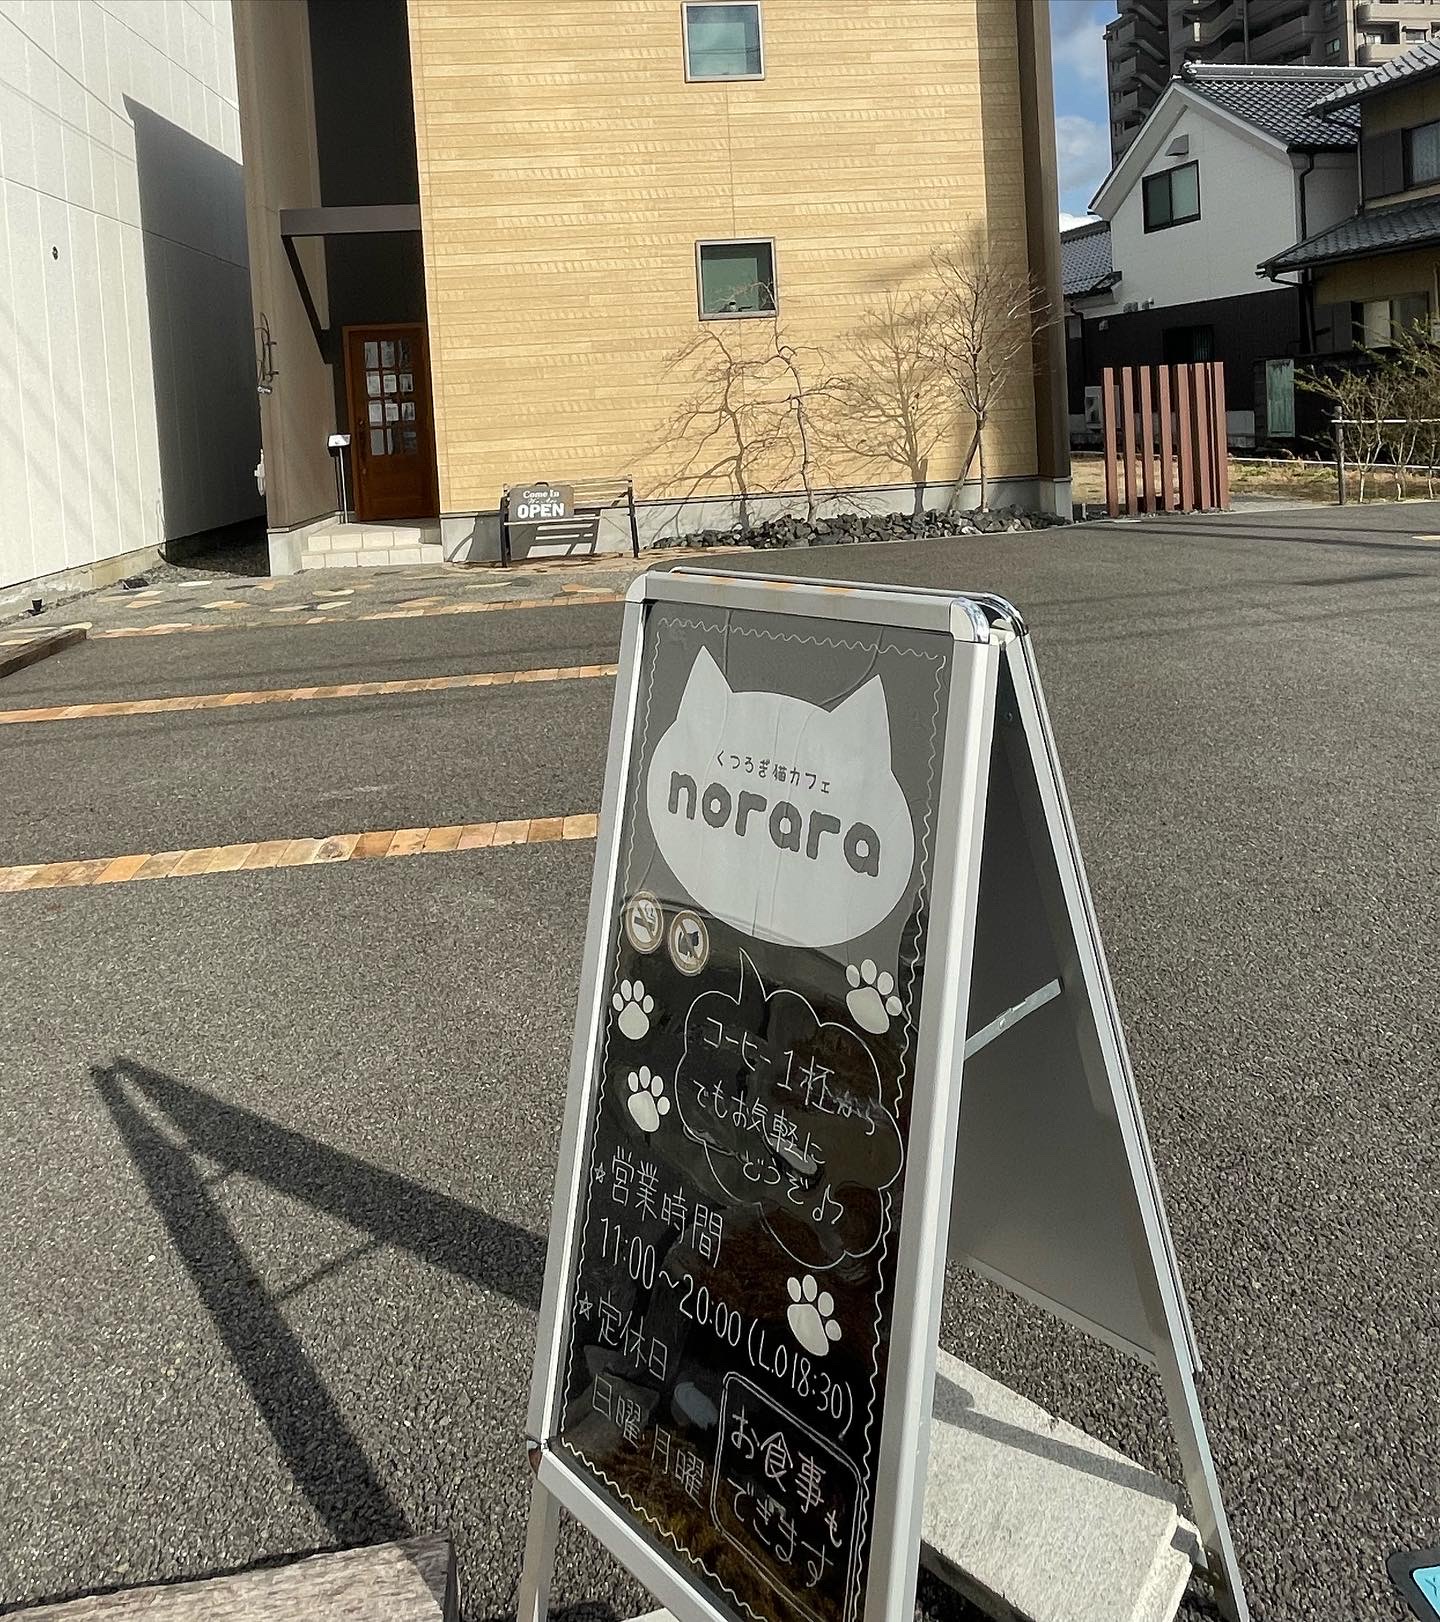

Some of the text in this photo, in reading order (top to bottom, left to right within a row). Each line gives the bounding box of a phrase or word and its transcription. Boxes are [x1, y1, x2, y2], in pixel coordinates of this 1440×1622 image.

[517, 502, 565, 519] OPEN
[716, 750, 831, 794] くつろぎ猫カフェ
[667, 770, 881, 878] norara
[692, 1078, 826, 1164] でもお気軽に
[611, 1145, 723, 1268] 営業時間
[598, 1290, 668, 1381] 定休日
[730, 1404, 843, 1548] お食事も
[726, 1476, 834, 1588] できます
